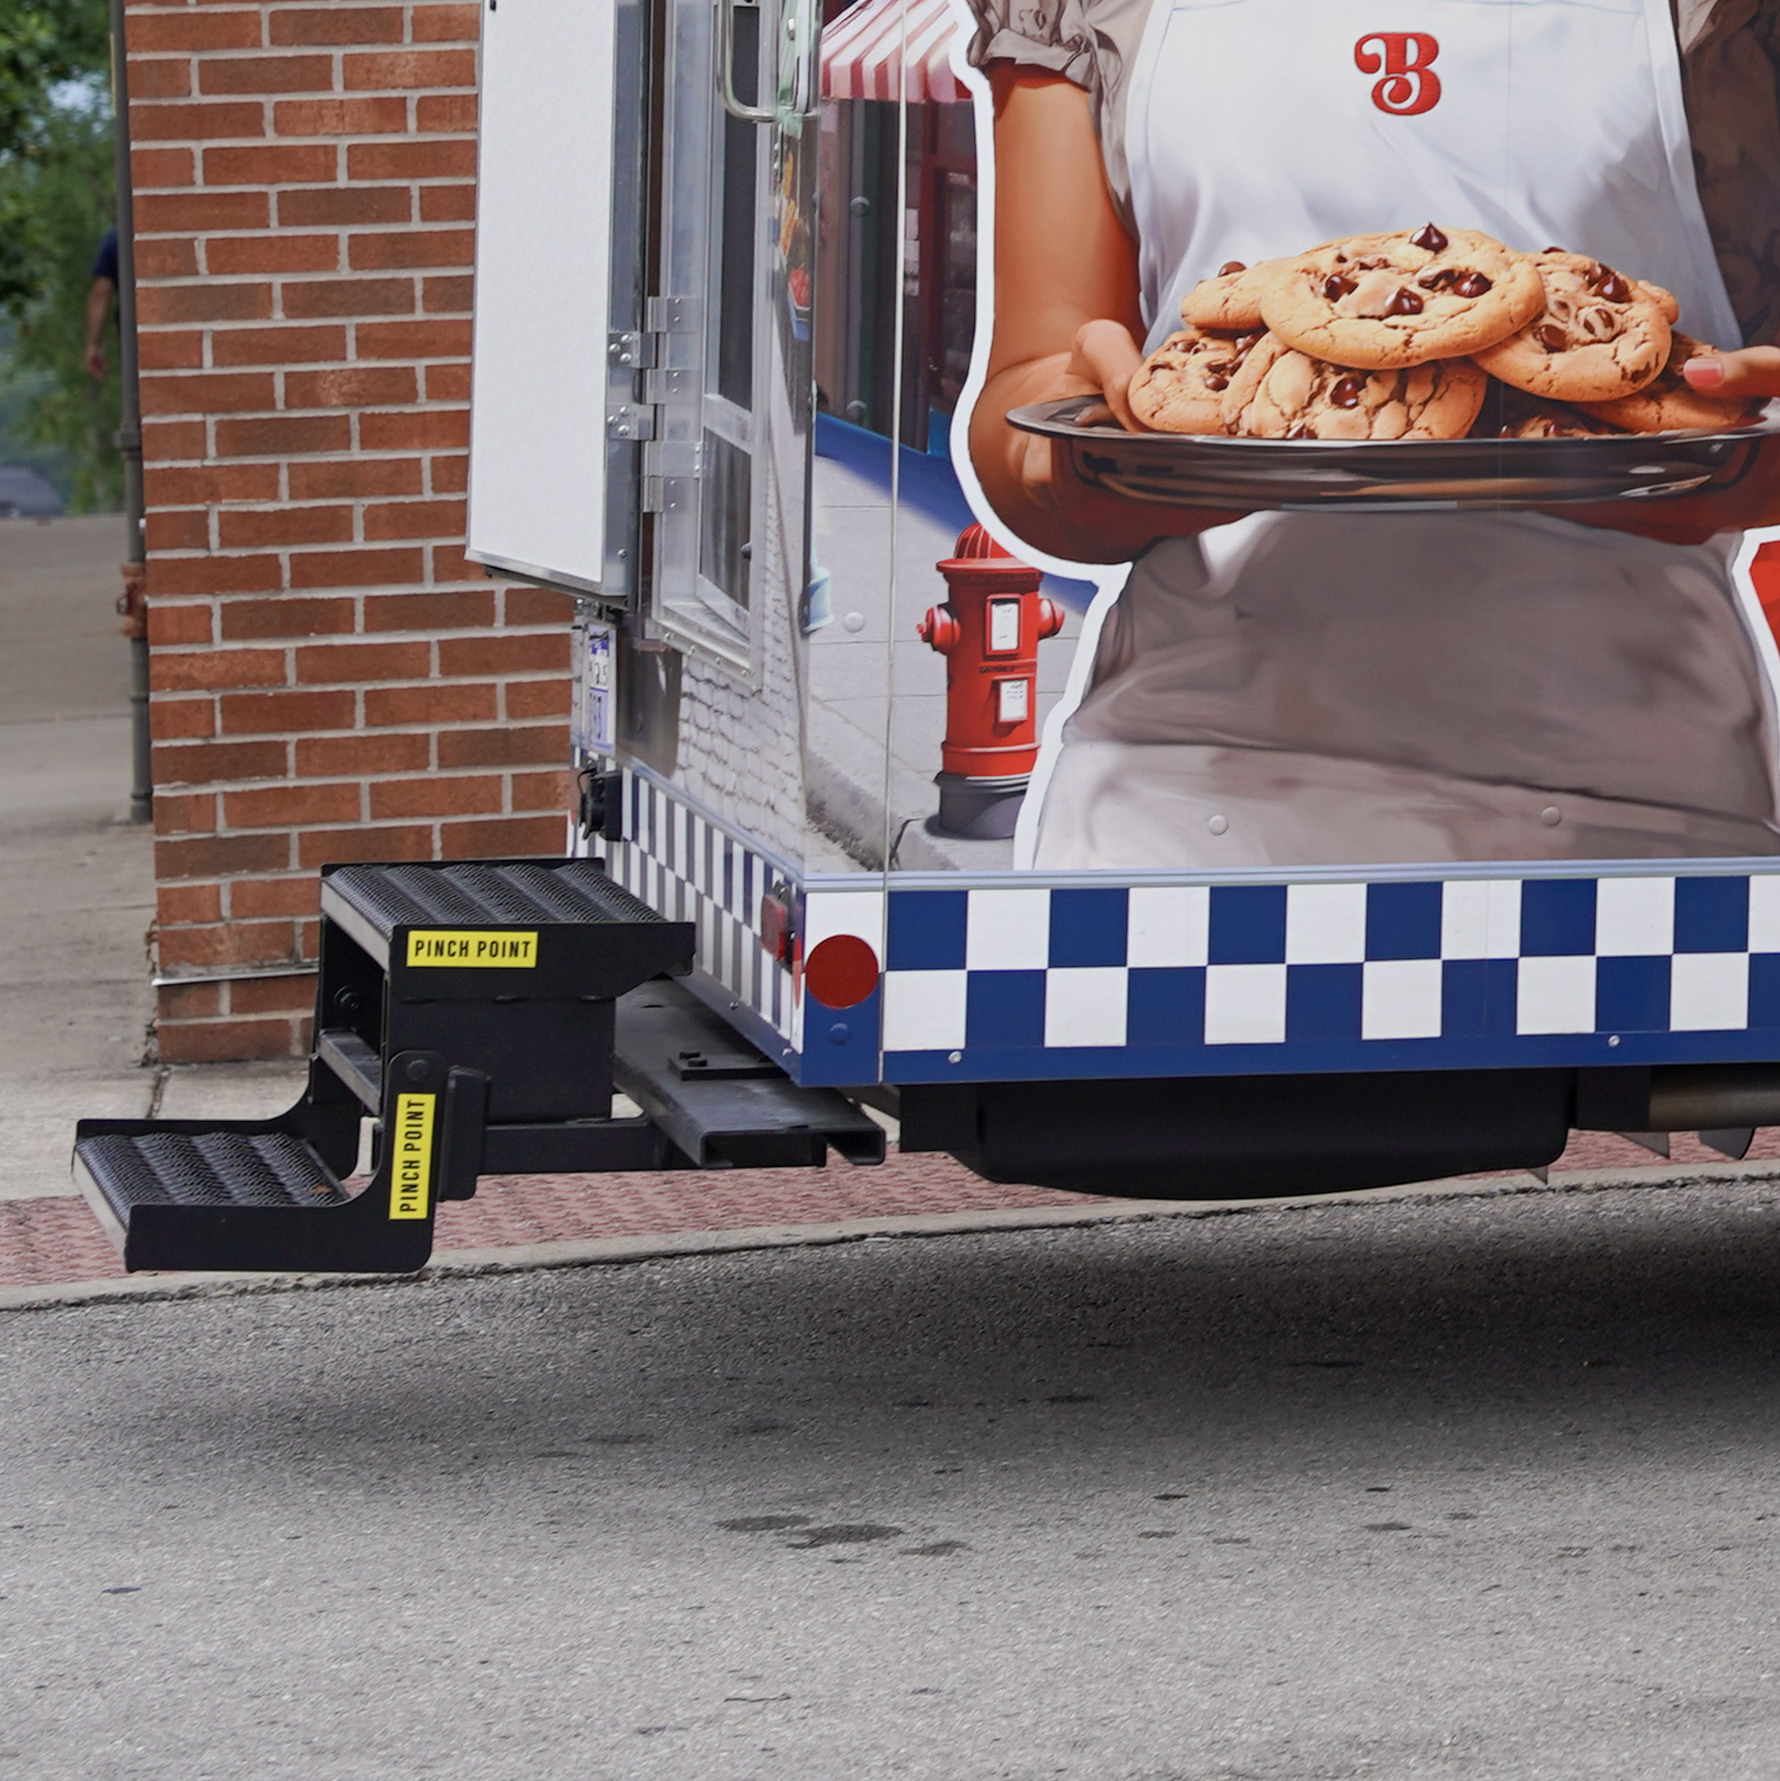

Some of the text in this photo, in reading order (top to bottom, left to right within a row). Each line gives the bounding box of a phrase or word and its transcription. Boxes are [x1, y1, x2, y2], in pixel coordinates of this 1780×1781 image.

[1354, 32, 1442, 116] B
[414, 940, 531, 959] PINCH POINT
[400, 1100, 425, 1212] PINCH POINT
